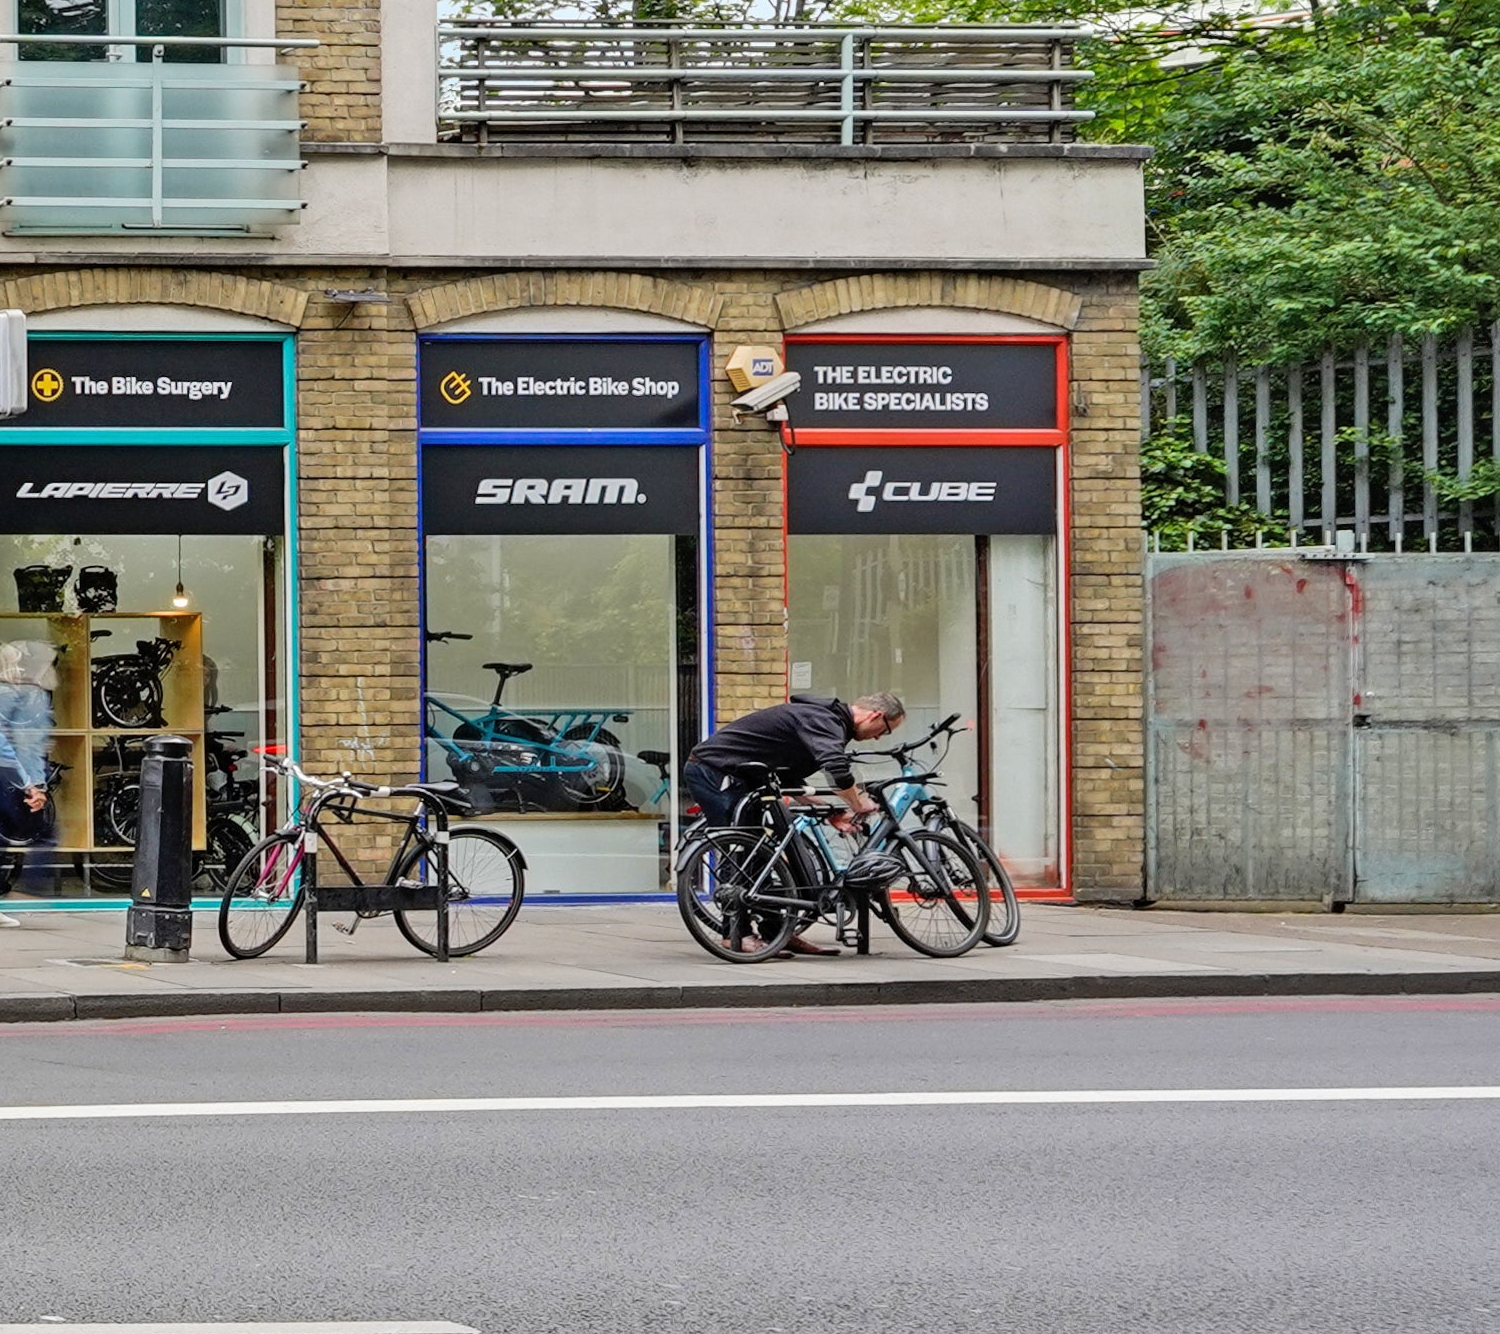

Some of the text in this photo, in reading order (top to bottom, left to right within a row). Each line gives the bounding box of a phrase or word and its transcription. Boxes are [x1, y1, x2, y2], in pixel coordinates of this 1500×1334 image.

[752, 361, 774, 374] ADT
[814, 366, 952, 384] THE ELECTRIC
[71, 376, 232, 399] The Bike Surgery
[478, 377, 680, 399] The Electric Bike Shop
[814, 392, 988, 411] BIKE SPECIALISTS
[16, 483, 205, 498] LAPIERRE
[882, 482, 997, 501] CUBE
